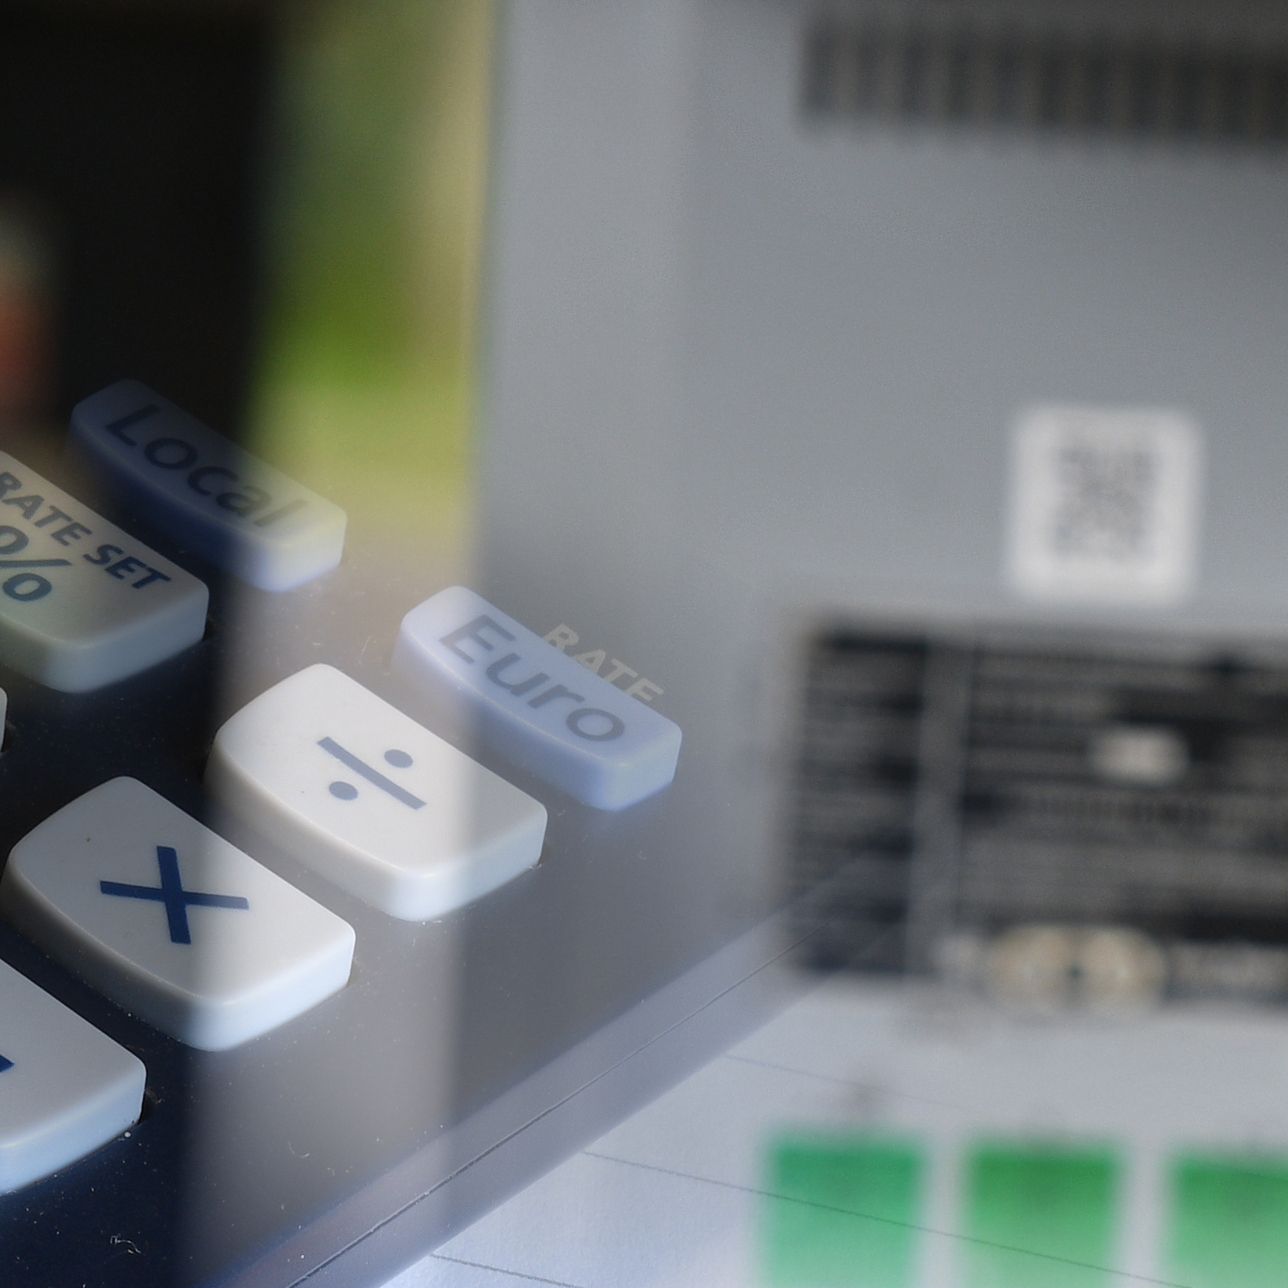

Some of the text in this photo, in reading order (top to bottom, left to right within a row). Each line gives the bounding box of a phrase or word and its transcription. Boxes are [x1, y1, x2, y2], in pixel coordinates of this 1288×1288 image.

[106, 403, 307, 528] Local
[0, 472, 172, 589] RATE SET
[438, 613, 626, 742] Euro
[542, 623, 665, 701] RATE
